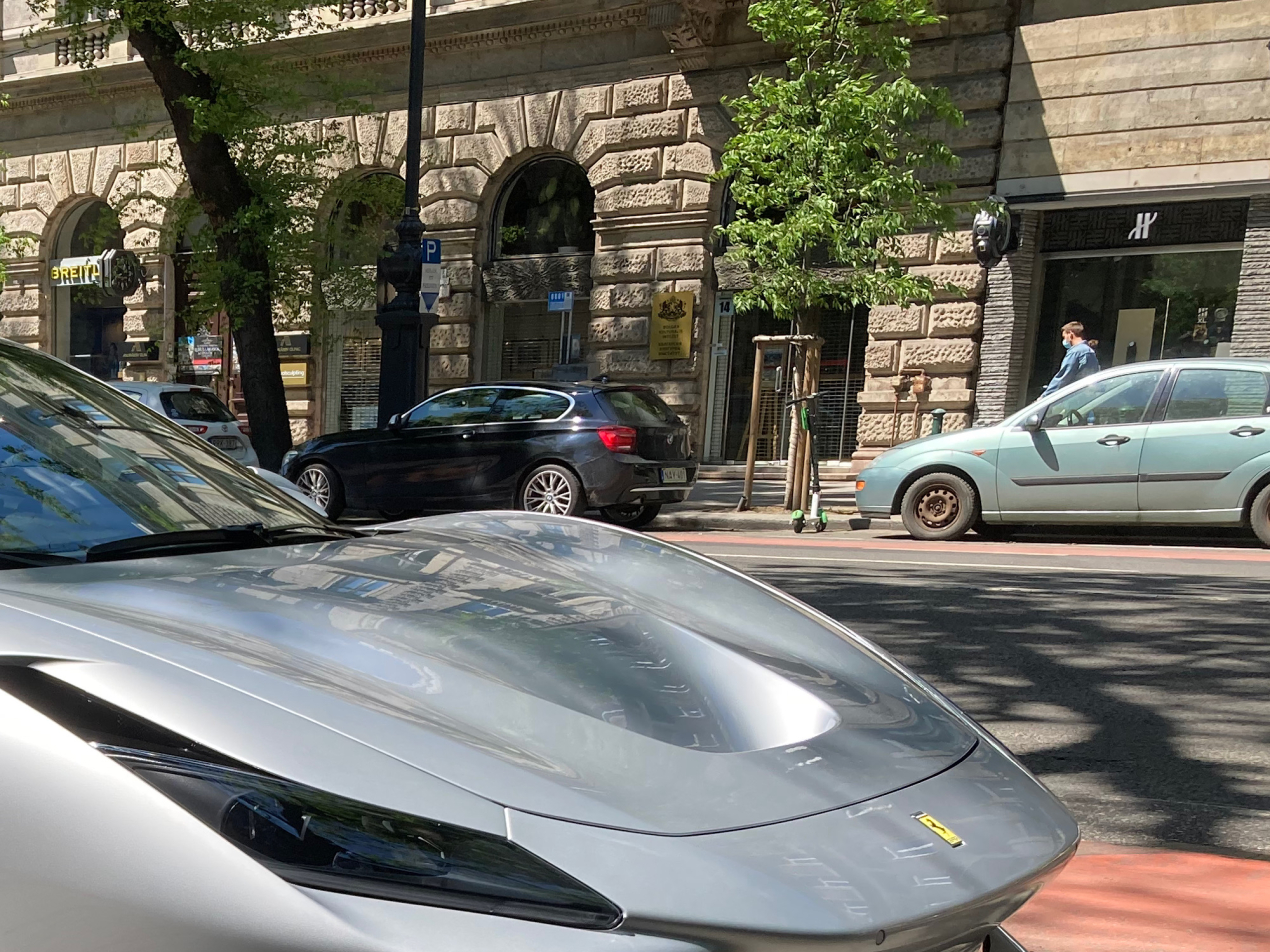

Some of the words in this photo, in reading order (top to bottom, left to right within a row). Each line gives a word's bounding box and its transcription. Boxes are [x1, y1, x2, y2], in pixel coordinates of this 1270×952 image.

[427, 241, 436, 261] P
[51, 264, 100, 279] BREITL
[720, 301, 730, 313] 14
